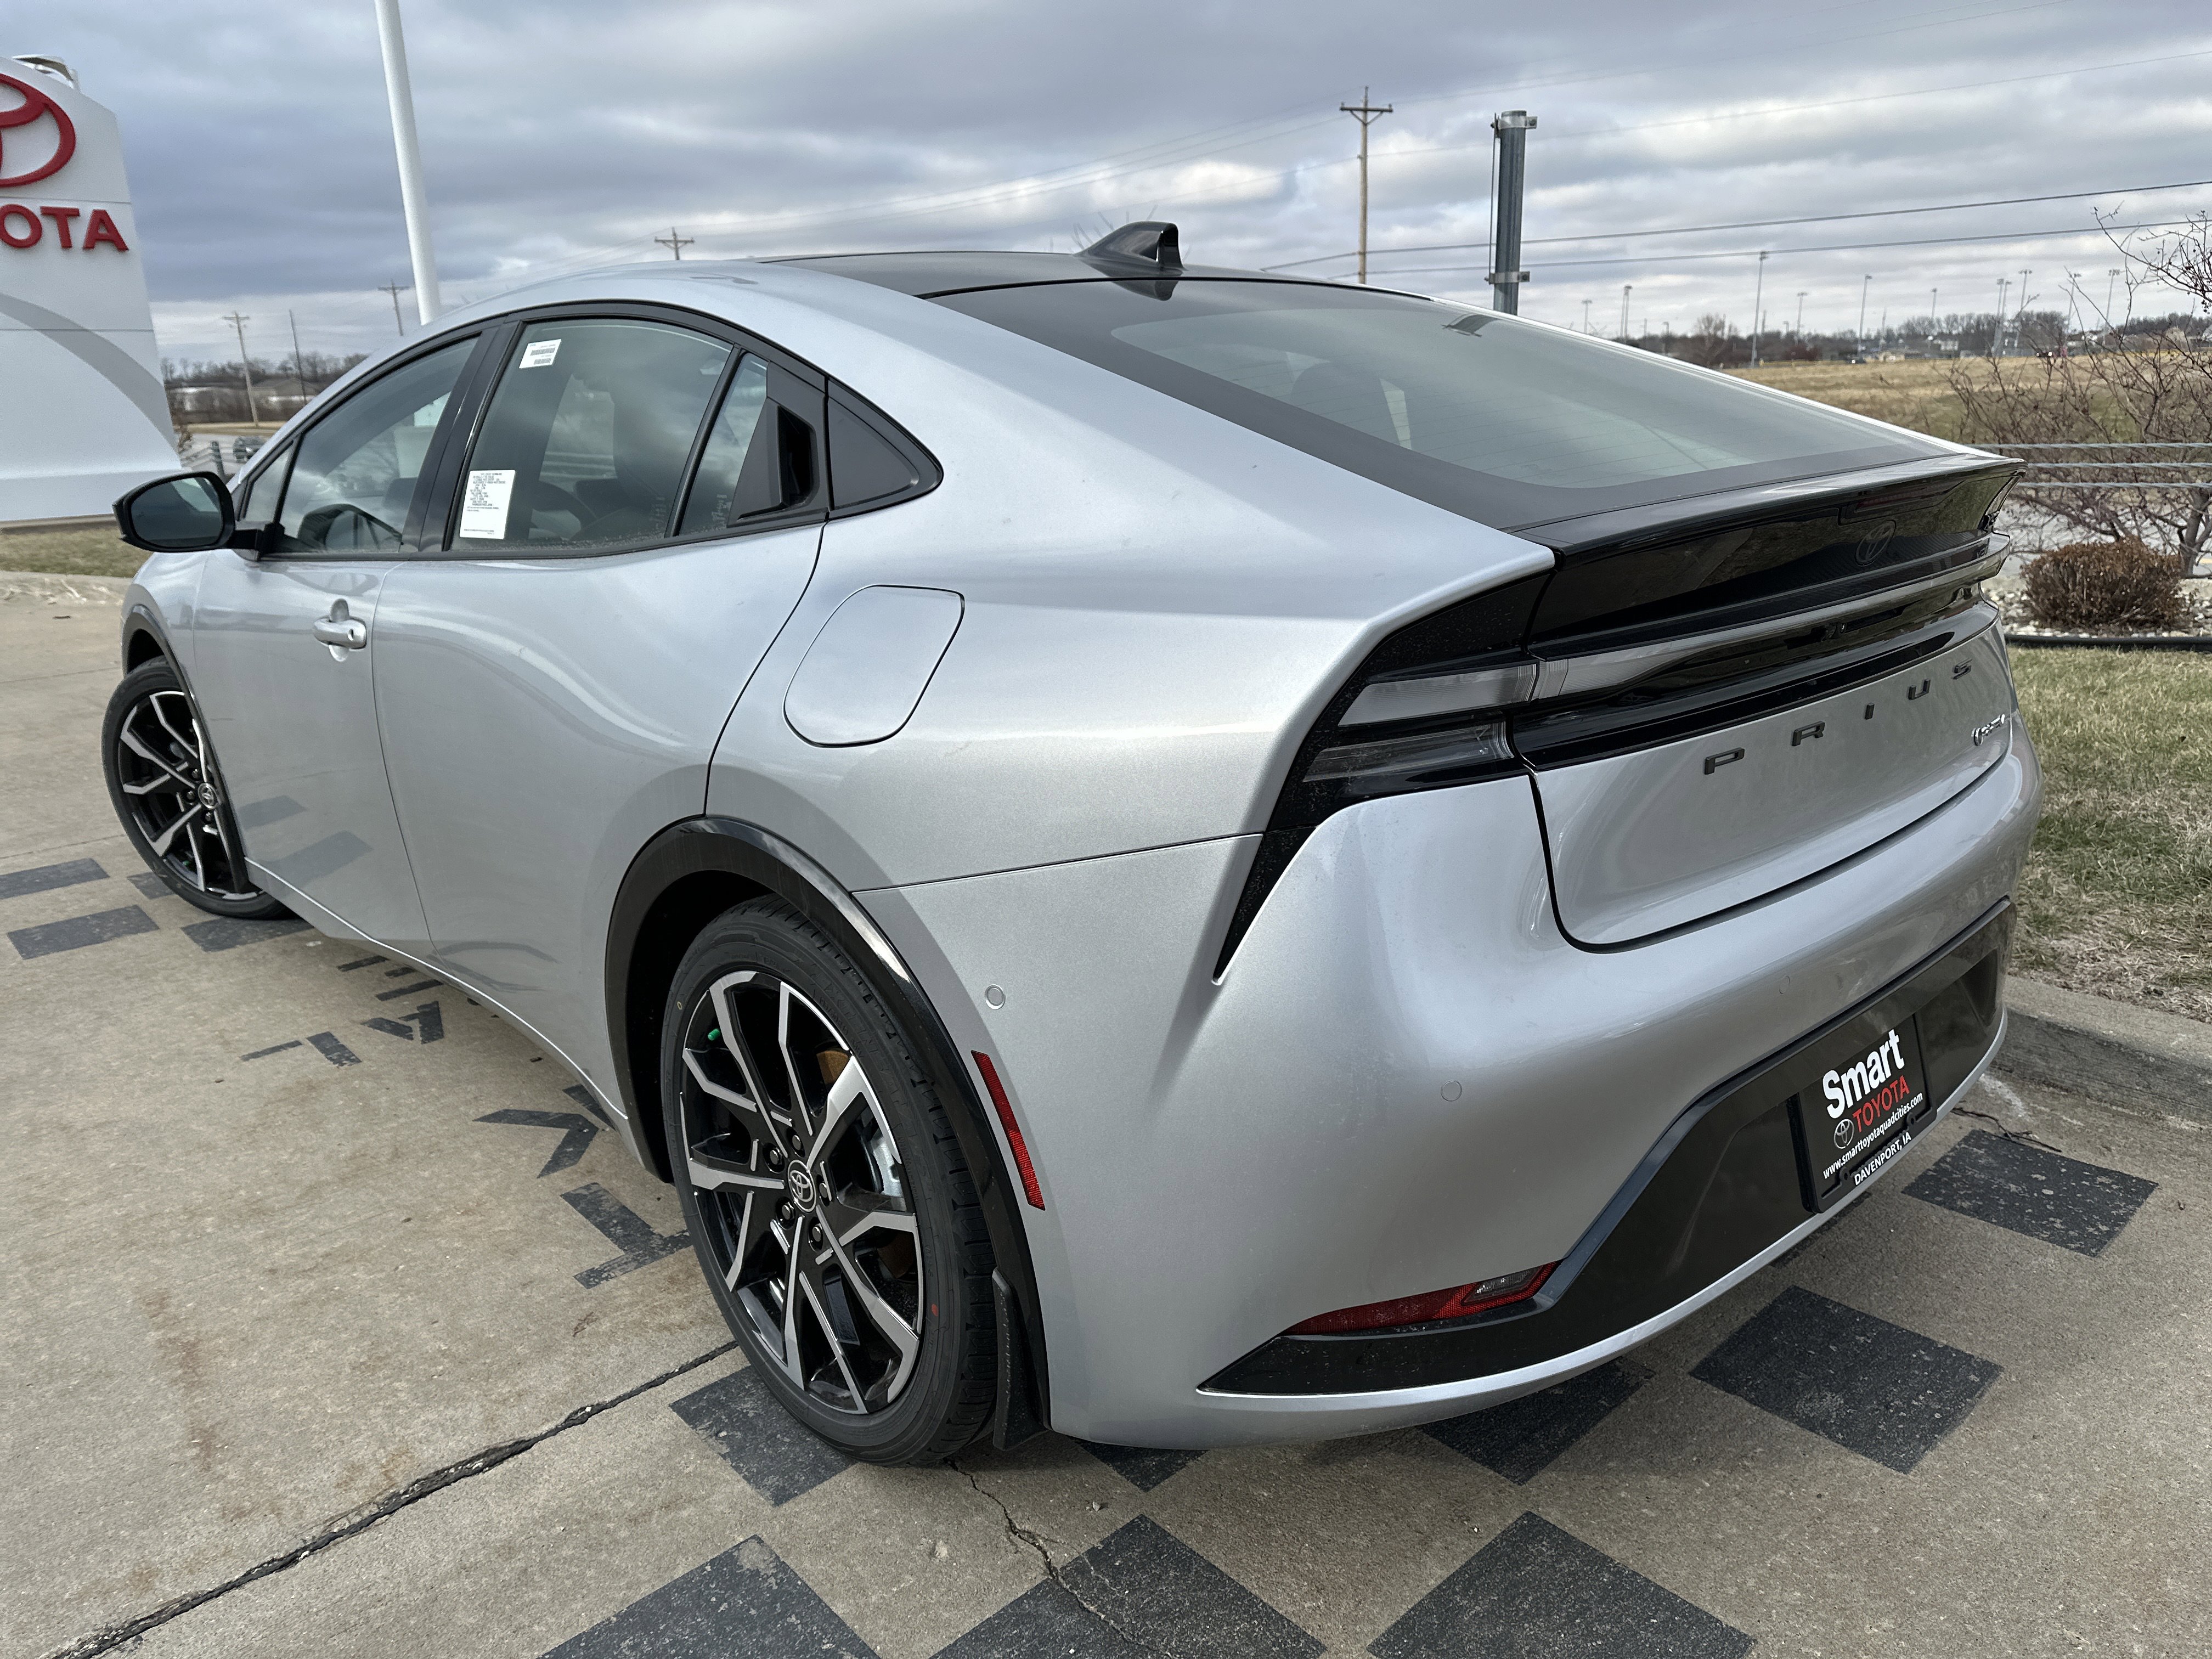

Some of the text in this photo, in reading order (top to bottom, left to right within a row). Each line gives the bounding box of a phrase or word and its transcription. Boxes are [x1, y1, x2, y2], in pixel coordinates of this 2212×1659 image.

[1704, 659, 1972, 775] PRIUS
[1822, 1029, 1905, 1119] Smart
[1852, 1075, 1910, 1132] TOYOTA
[1823, 1092, 1923, 1179] www.smarttoyotaquadcities.com
[1854, 1132, 1912, 1185] DAVENPORT, IA
